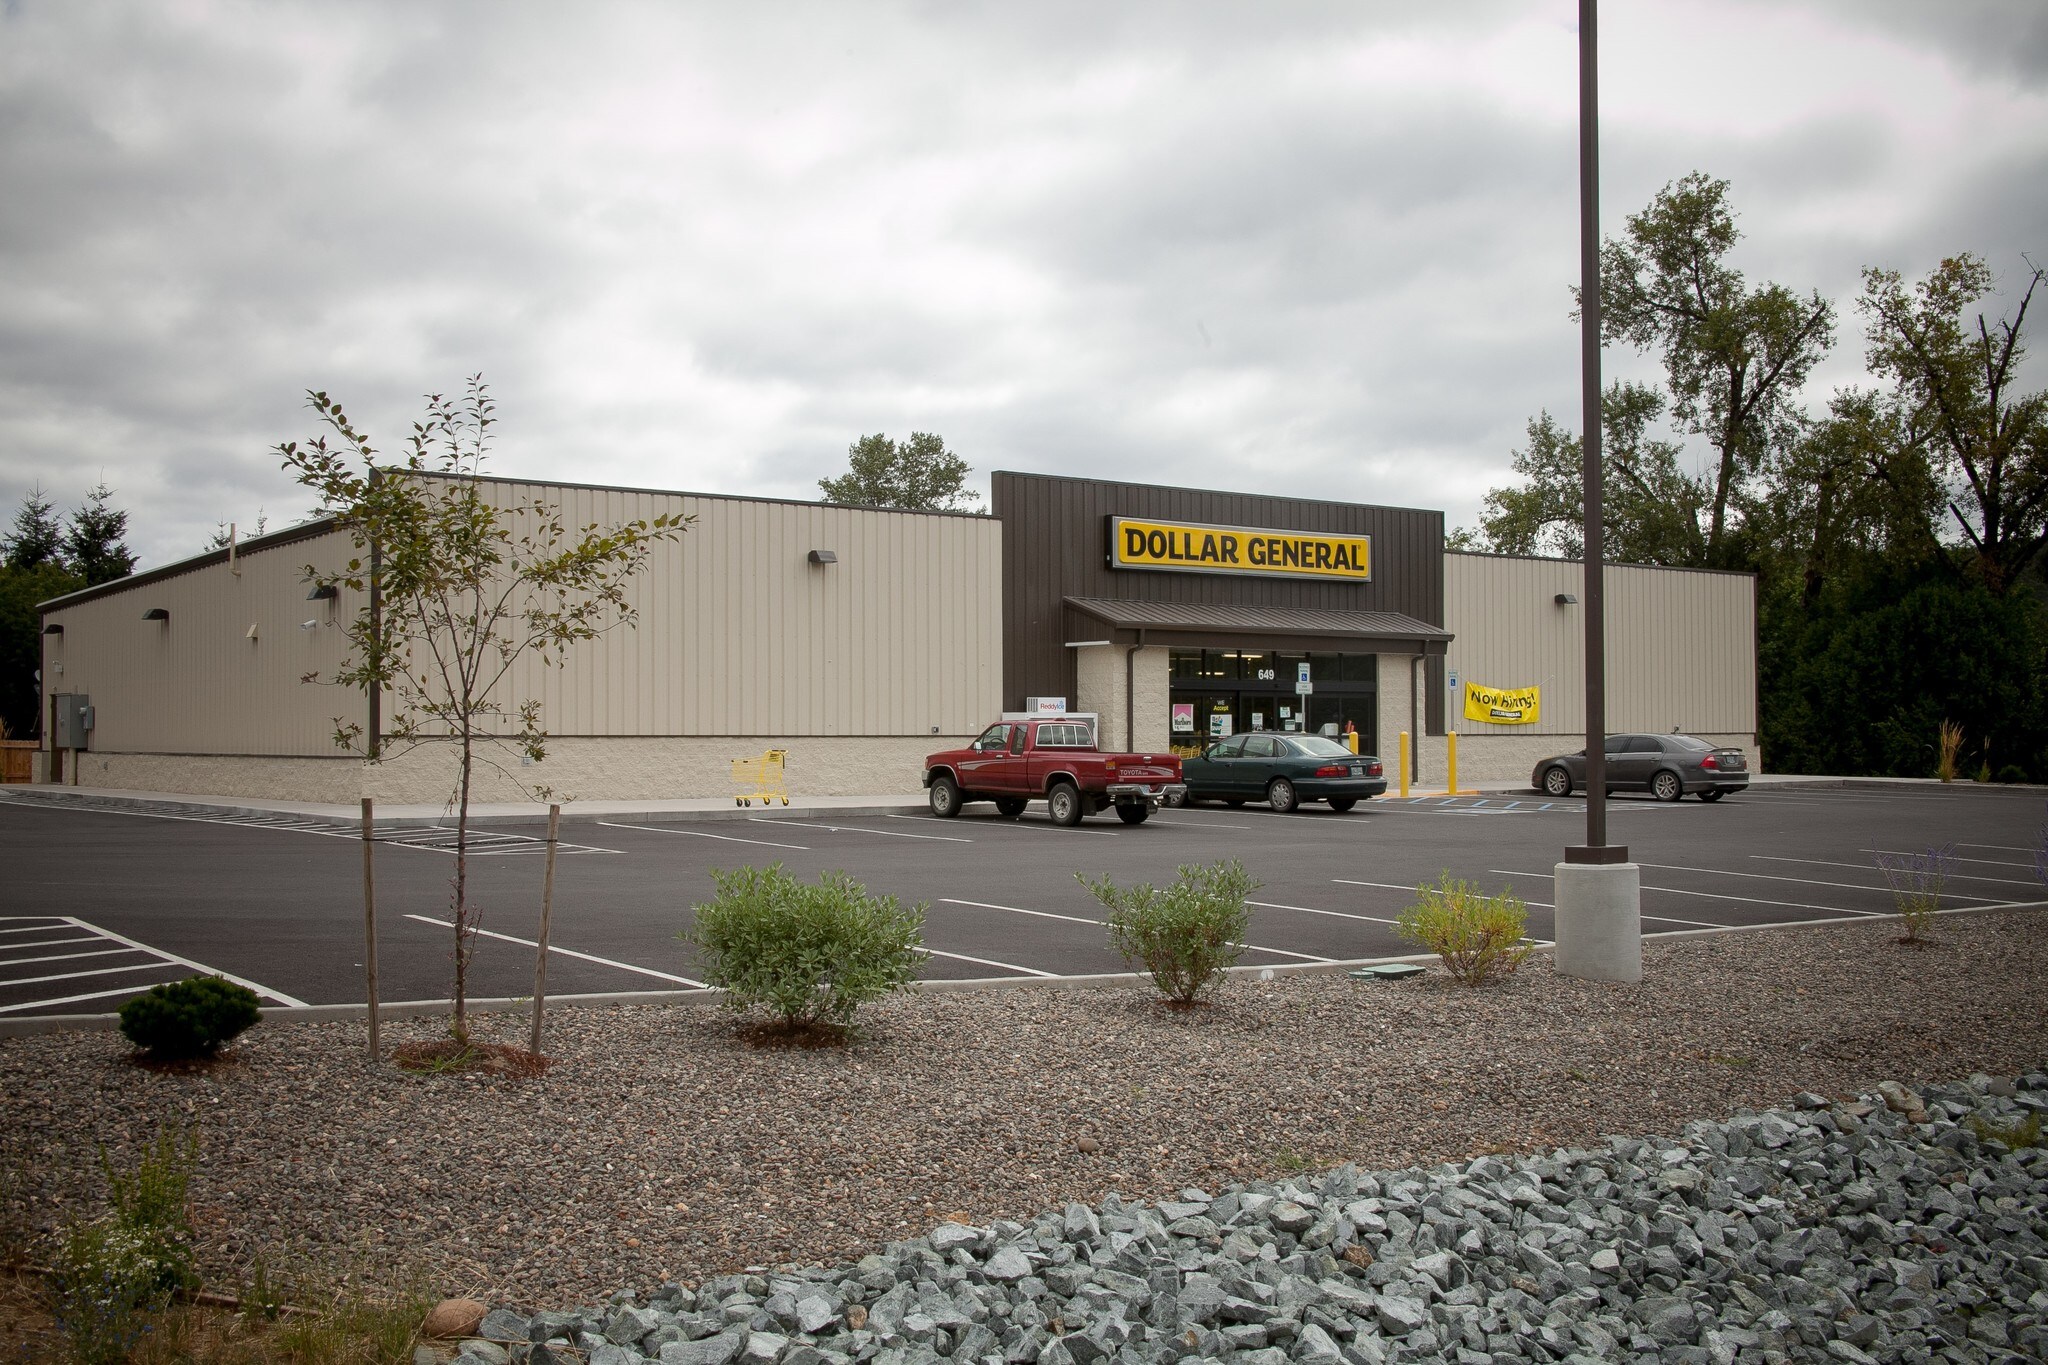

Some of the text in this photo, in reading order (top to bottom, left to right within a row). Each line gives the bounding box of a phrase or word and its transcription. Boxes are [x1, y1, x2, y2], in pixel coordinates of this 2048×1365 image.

[1125, 528, 1365, 571] DOLLAR GENERAL
[1258, 669, 1274, 680] 649
[1501, 693, 1536, 708] Hiring!
